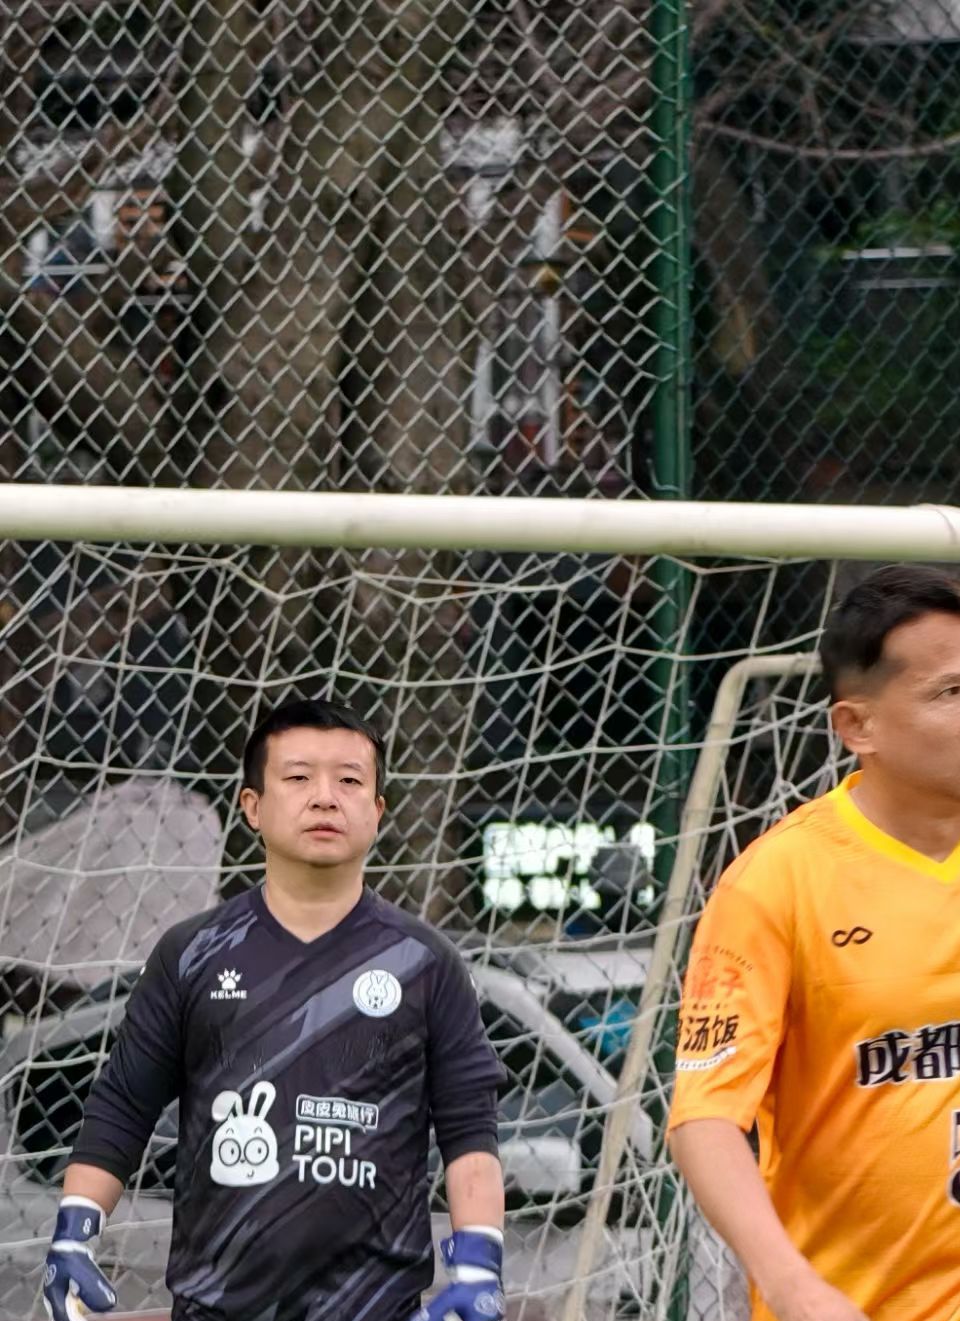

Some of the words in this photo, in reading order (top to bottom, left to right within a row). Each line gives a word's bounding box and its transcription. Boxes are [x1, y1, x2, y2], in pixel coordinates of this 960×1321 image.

[210, 989, 248, 1000] KELME
[295, 1124, 351, 1156] PIPI
[292, 1154, 377, 1189] TOUR
